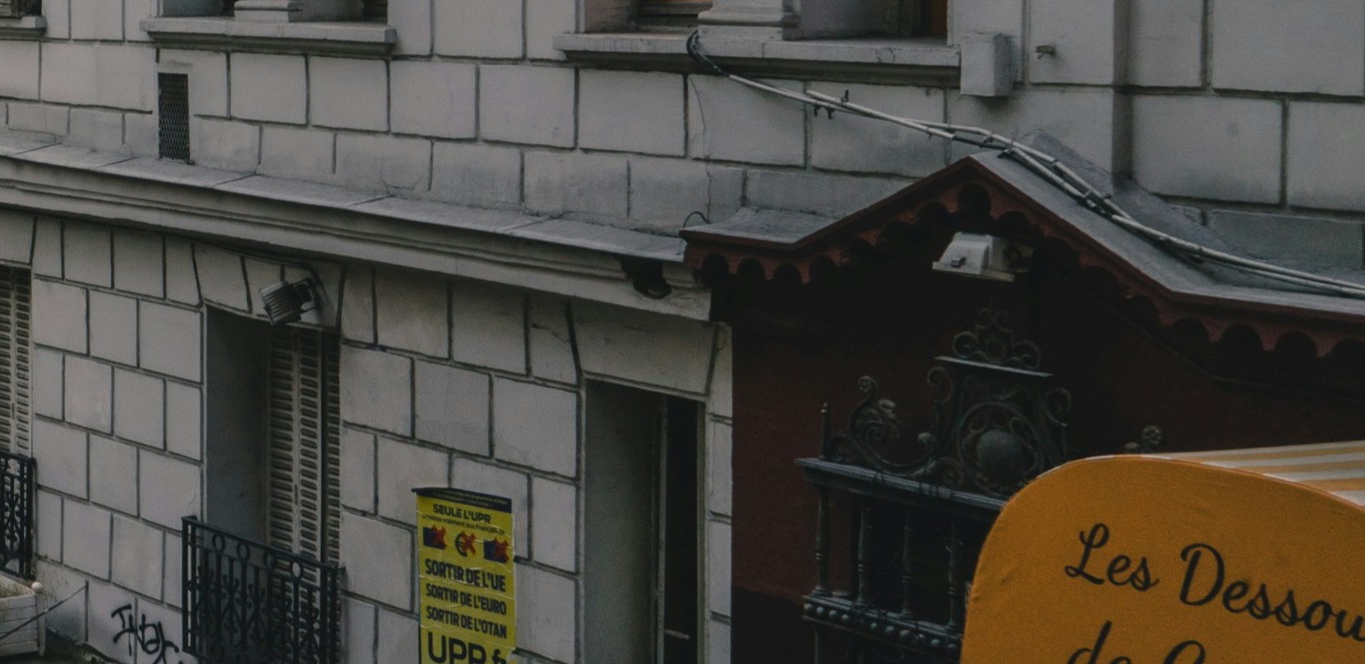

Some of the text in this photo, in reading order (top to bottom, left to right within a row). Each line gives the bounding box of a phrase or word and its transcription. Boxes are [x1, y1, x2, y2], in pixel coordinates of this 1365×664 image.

[432, 503, 462, 518] SEULE
[463, 509, 491, 524] L'UPR
[1064, 522, 1159, 592] Les
[425, 558, 506, 593] SORTIR DE L'UE
[426, 583, 507, 616] SORTIR DE L'EURO
[426, 606, 507, 639] SORTIR DE L'OTAN
